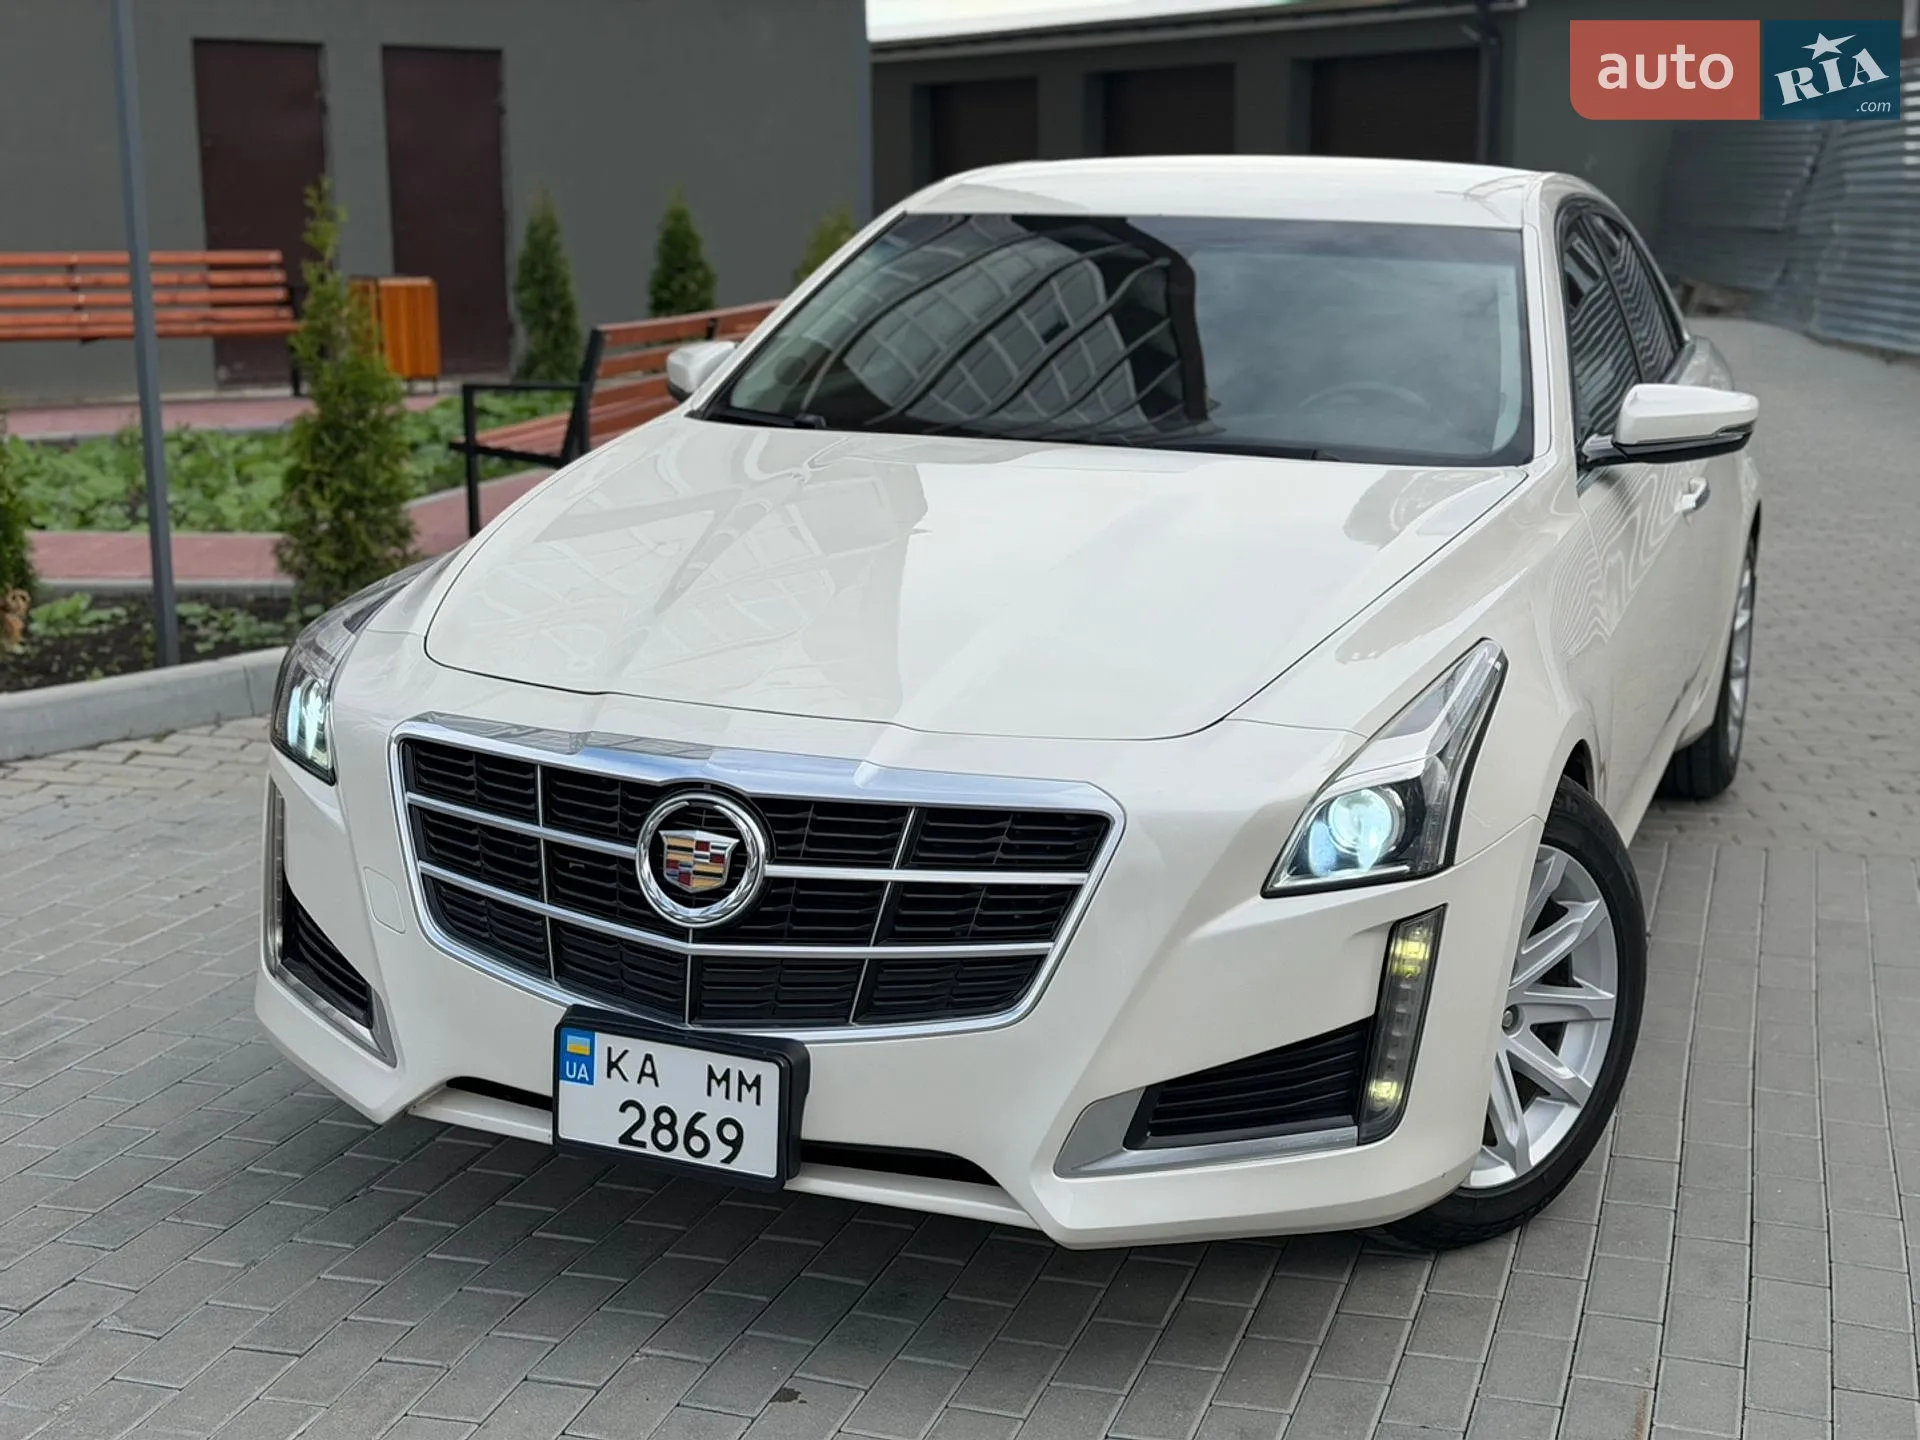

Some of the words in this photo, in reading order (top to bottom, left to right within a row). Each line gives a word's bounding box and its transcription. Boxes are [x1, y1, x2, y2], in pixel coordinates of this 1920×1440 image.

[565, 1061, 589, 1081] UA
[606, 1046, 660, 1088] KA
[706, 1064, 762, 1106] MM
[618, 1099, 744, 1164] 2869
